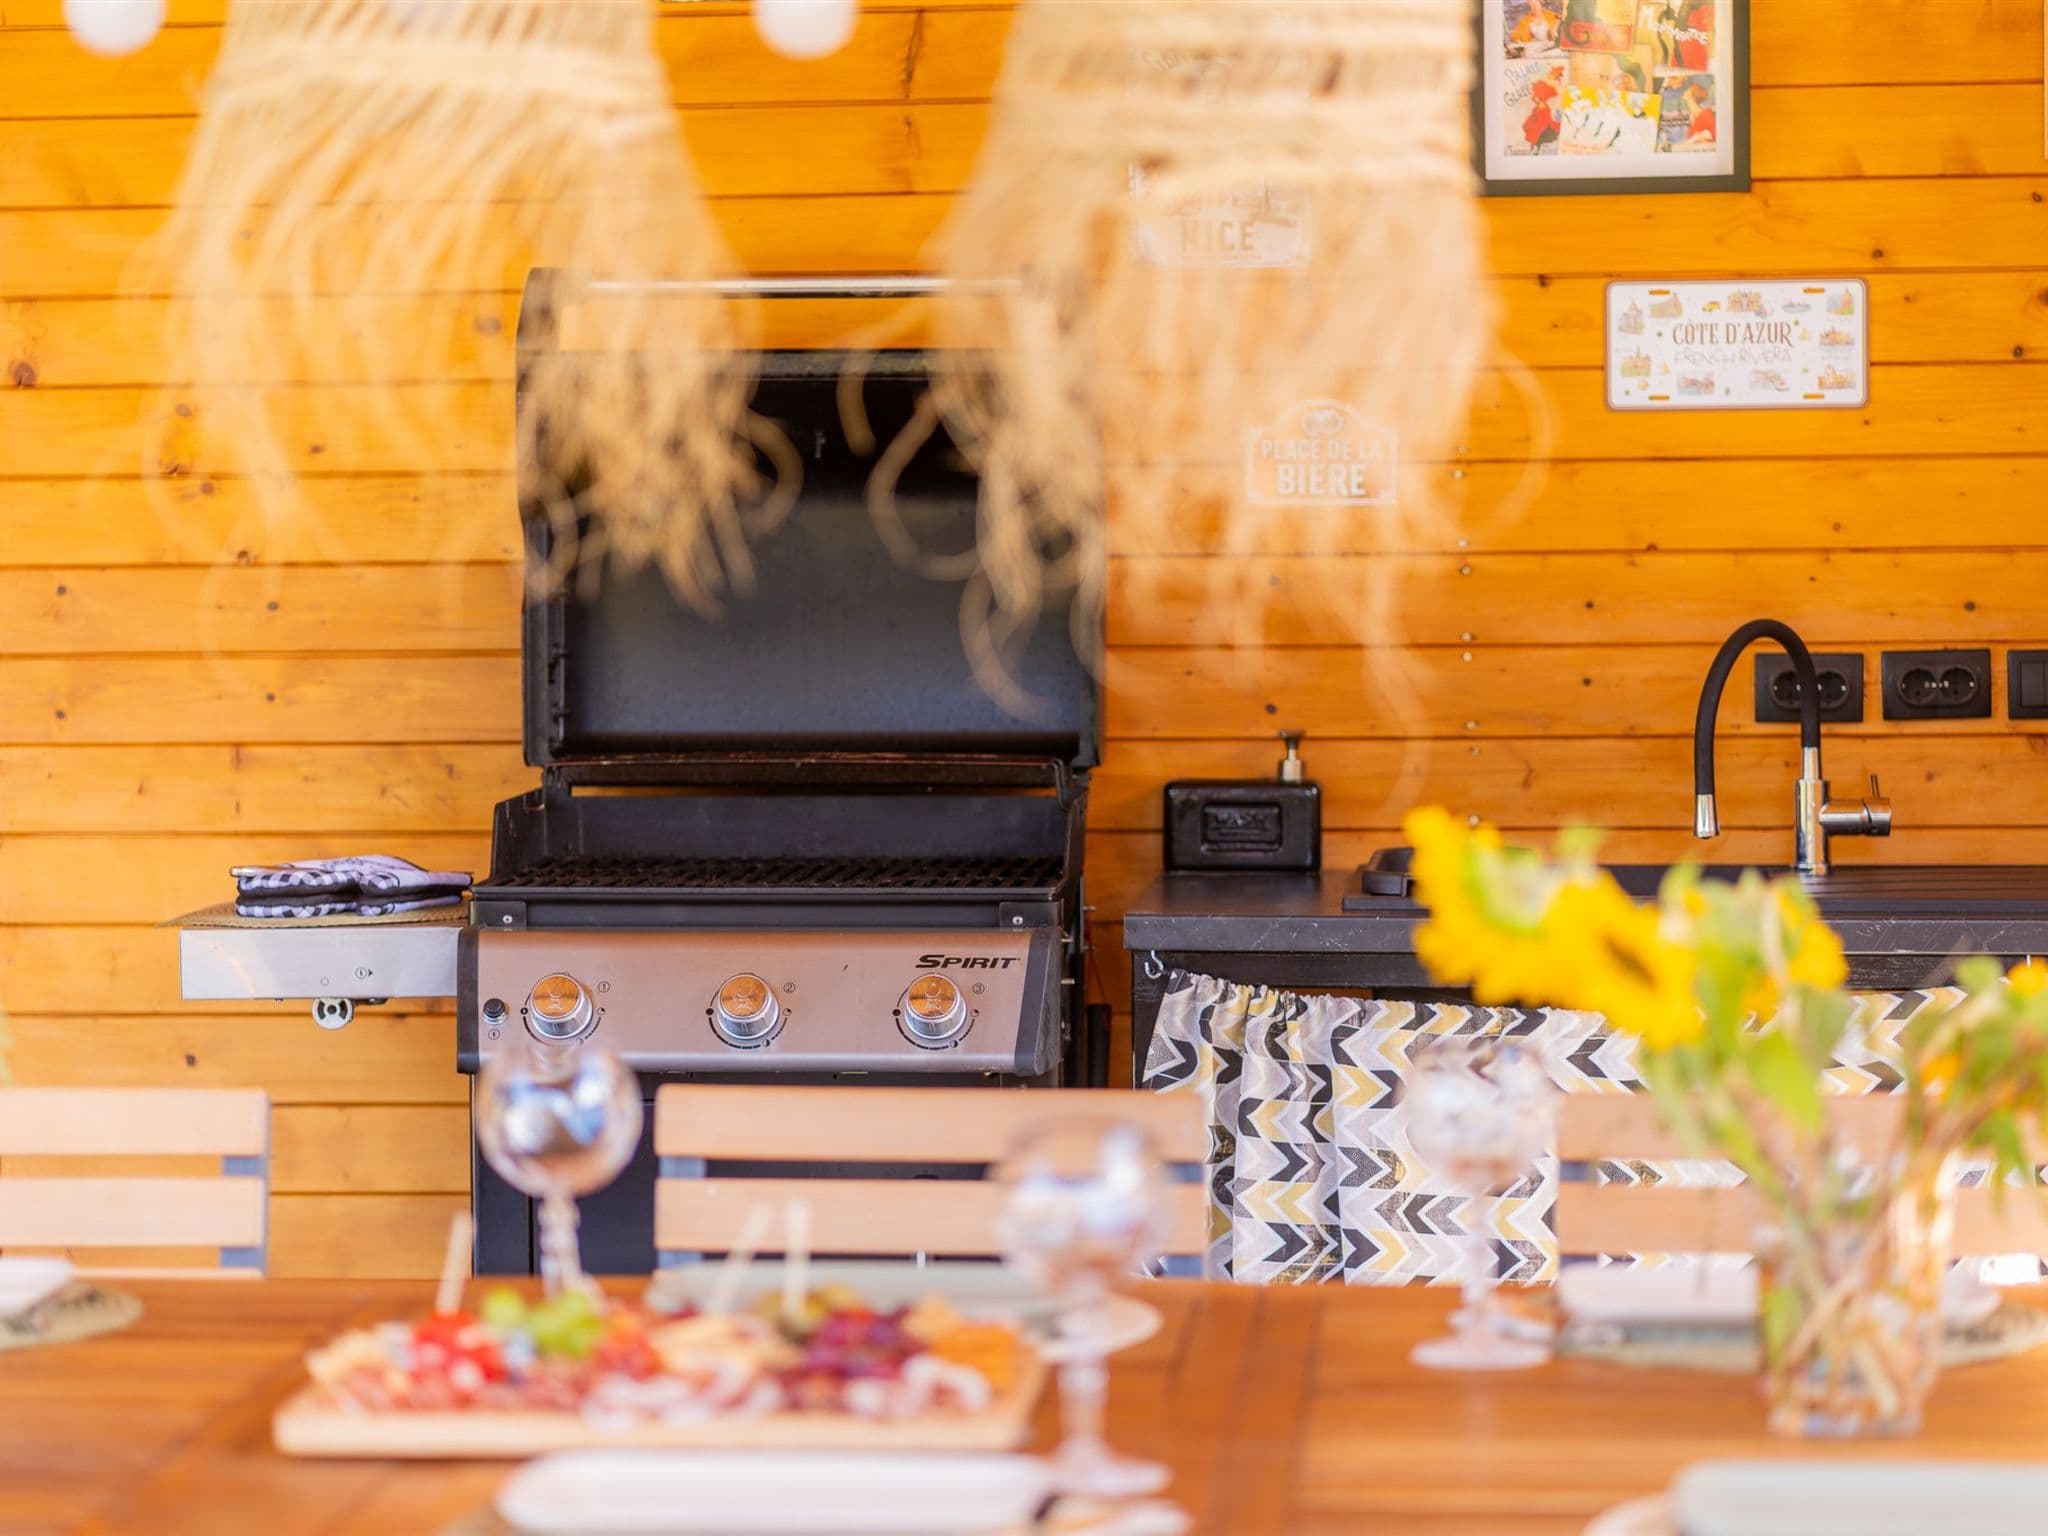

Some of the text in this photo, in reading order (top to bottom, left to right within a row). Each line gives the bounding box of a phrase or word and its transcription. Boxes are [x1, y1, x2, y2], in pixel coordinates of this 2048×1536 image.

[1181, 220, 1255, 251] NICE
[1726, 322, 1793, 348] D'AZUR
[1261, 439, 1383, 459] PLACE DE LA
[915, 954, 1018, 969] SPIRIT
